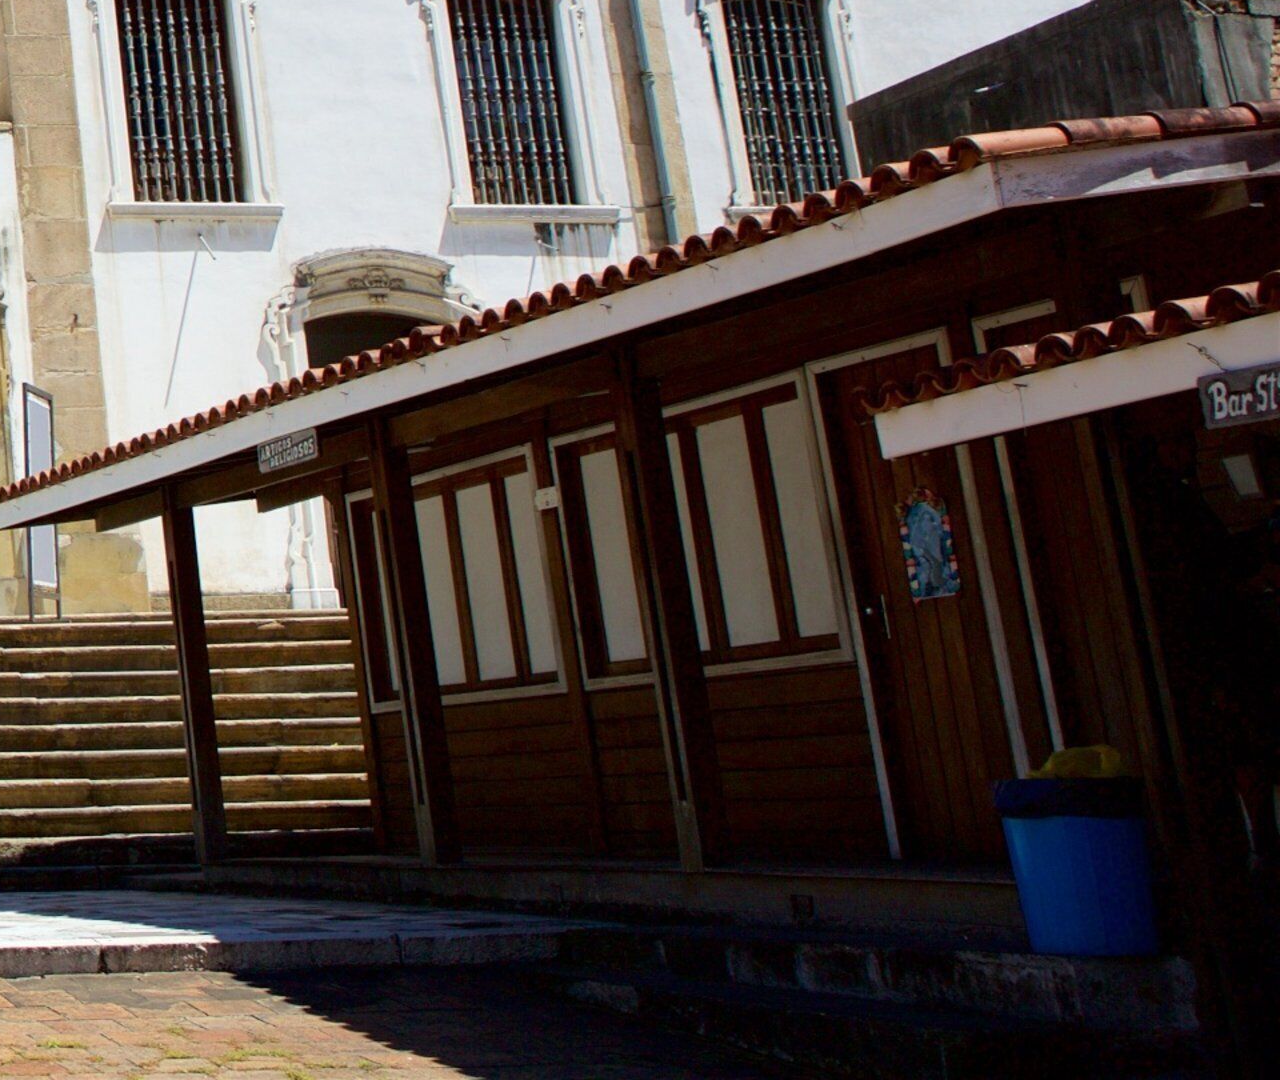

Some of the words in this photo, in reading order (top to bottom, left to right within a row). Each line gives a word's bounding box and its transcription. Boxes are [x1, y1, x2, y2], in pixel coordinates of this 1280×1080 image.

[1207, 380, 1254, 420] Bar
[1255, 371, 1280, 413] St
[270, 438, 314, 468] RELIGIOSOS
